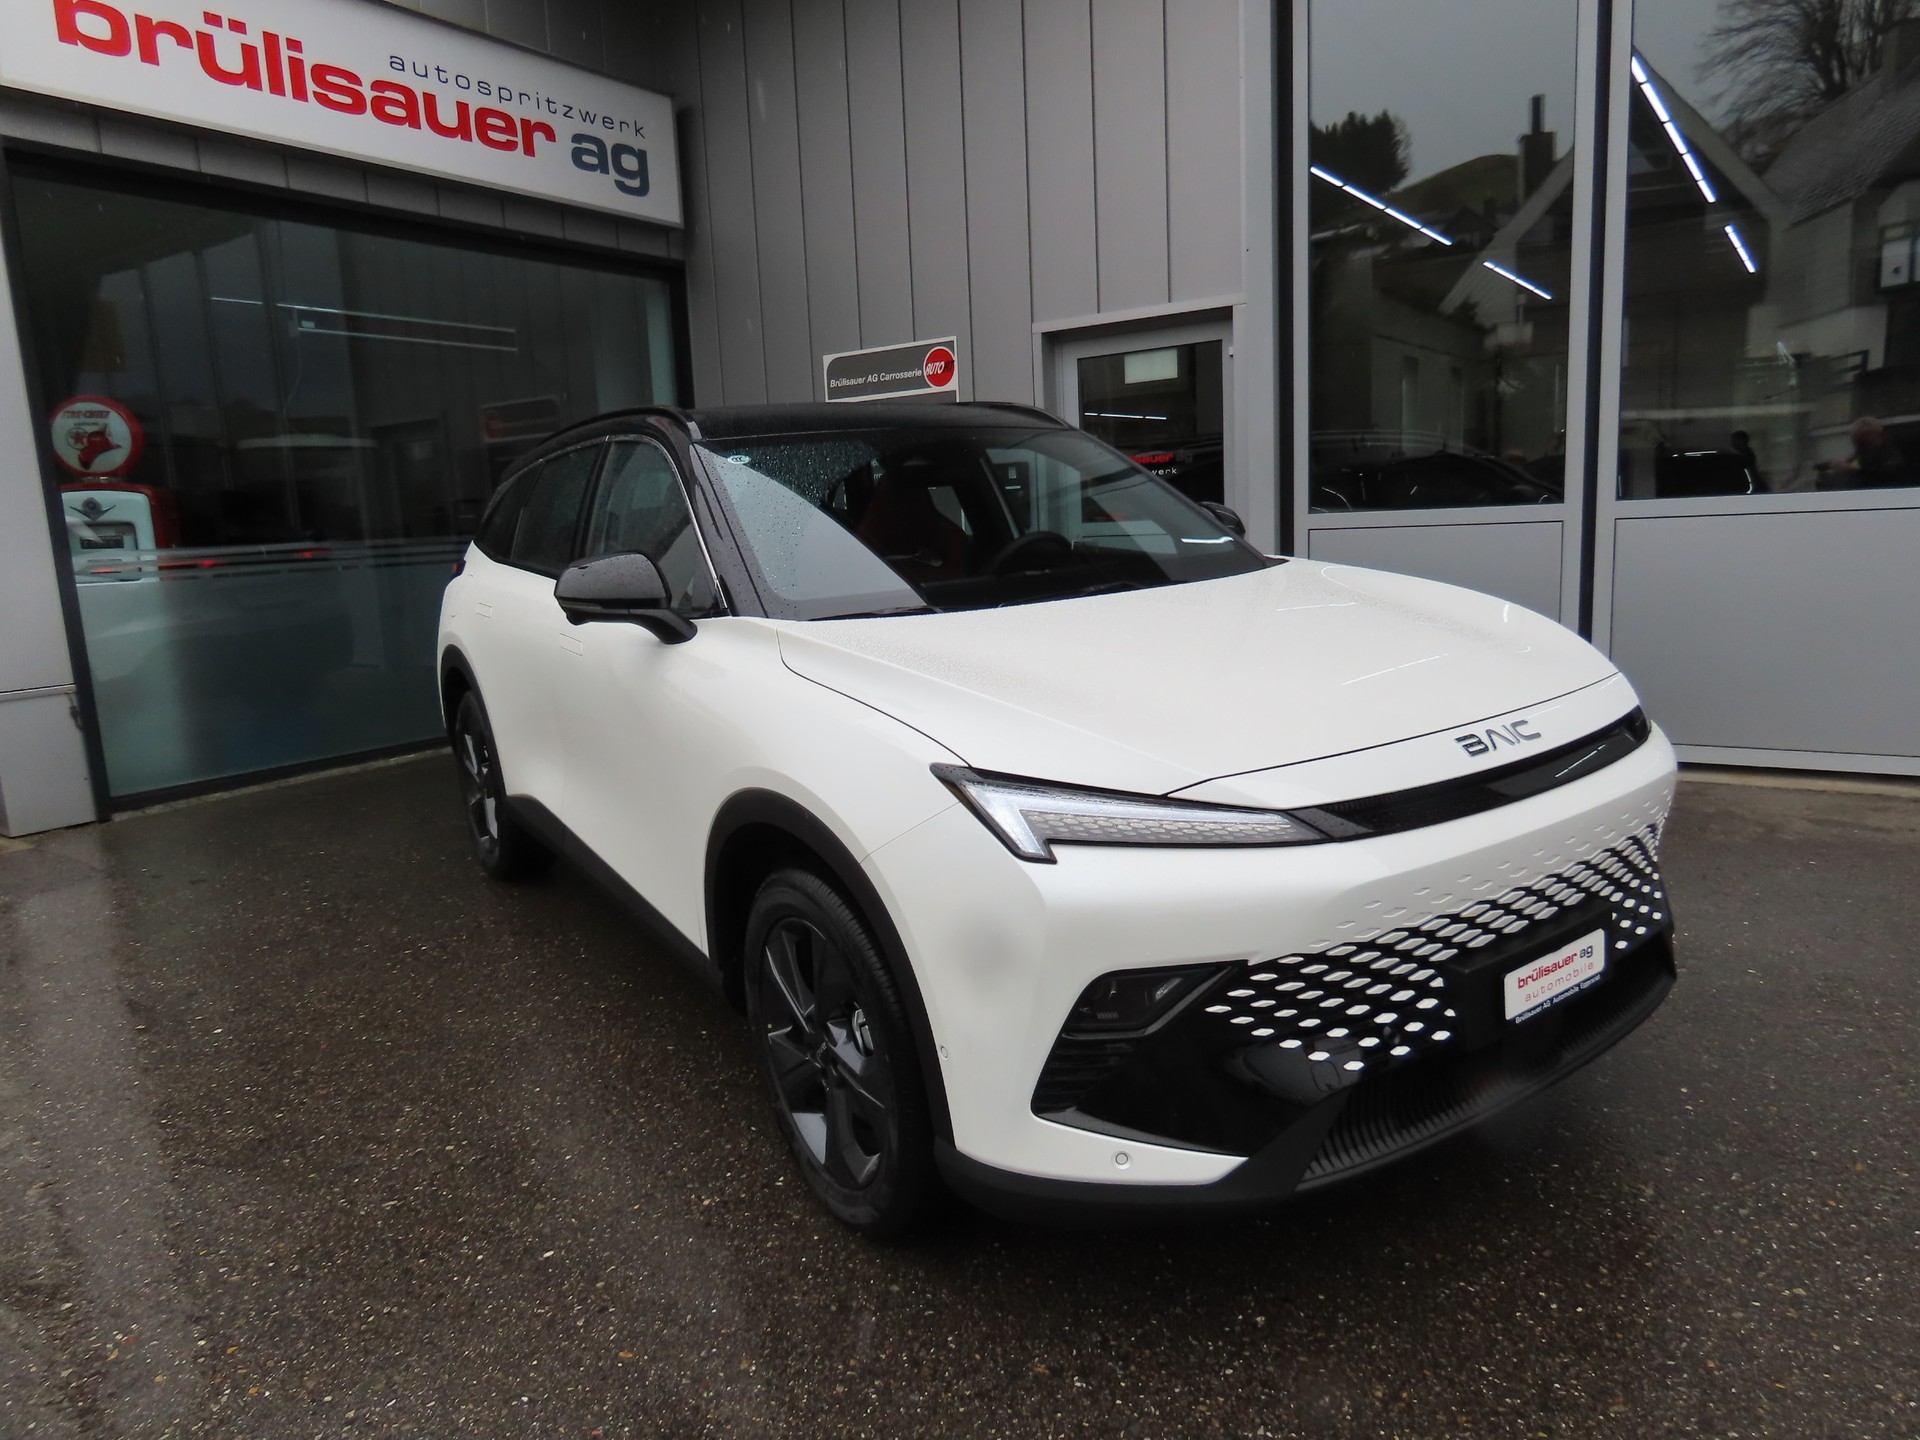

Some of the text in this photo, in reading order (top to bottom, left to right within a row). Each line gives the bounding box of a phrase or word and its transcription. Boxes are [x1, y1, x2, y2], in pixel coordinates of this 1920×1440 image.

[53, 0, 650, 198] brülisauer ag
[390, 54, 647, 140] autospritzwerk
[830, 368, 922, 388] Brülisauer AG Carrosserie
[1454, 719, 1542, 757] BAIC
[1517, 945, 1593, 989] brülisauer ag
[1525, 961, 1594, 1003] automobile
